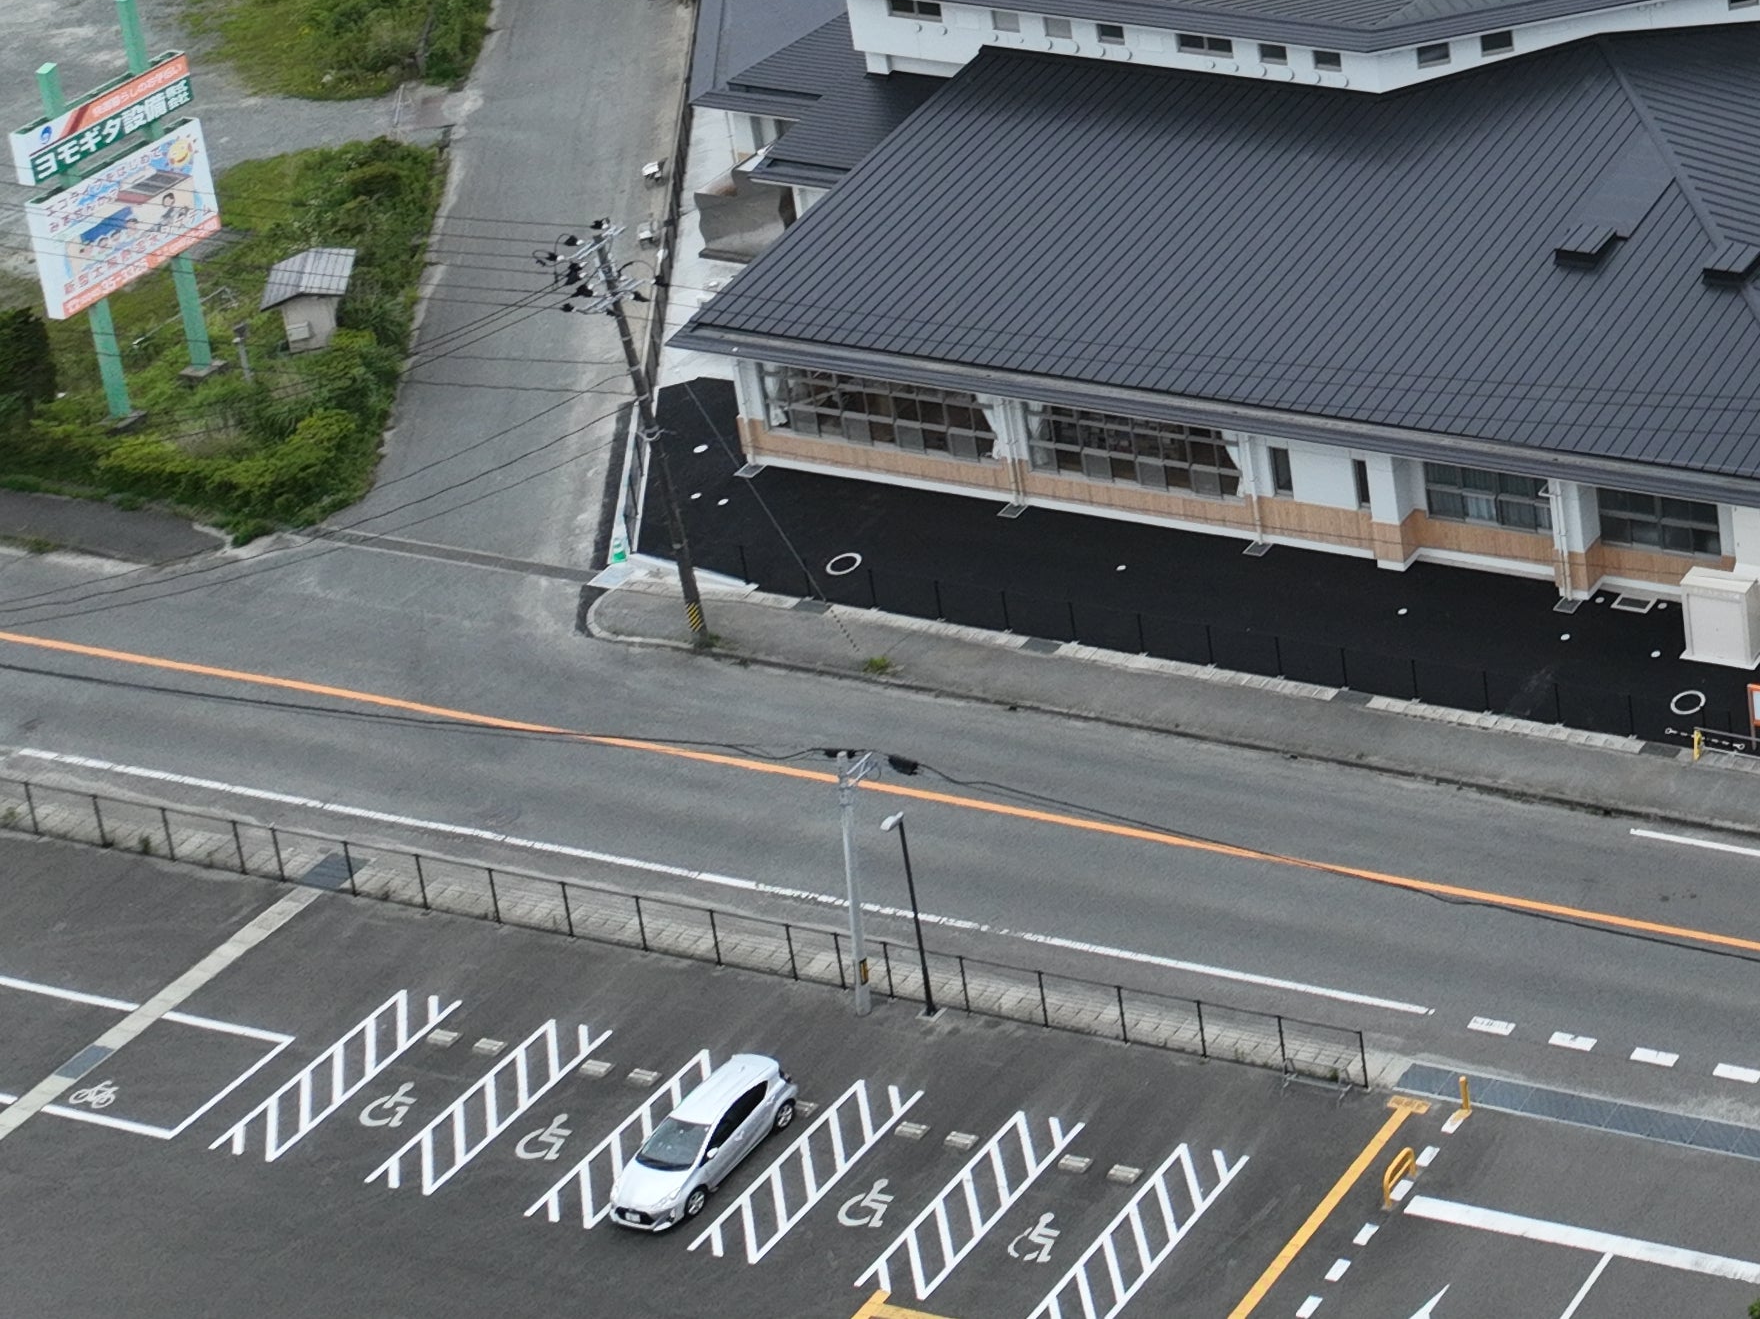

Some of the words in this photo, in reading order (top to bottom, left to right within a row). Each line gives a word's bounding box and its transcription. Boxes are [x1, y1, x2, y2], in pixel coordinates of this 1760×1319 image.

[35, 93, 167, 179] ヨモギタ設備
